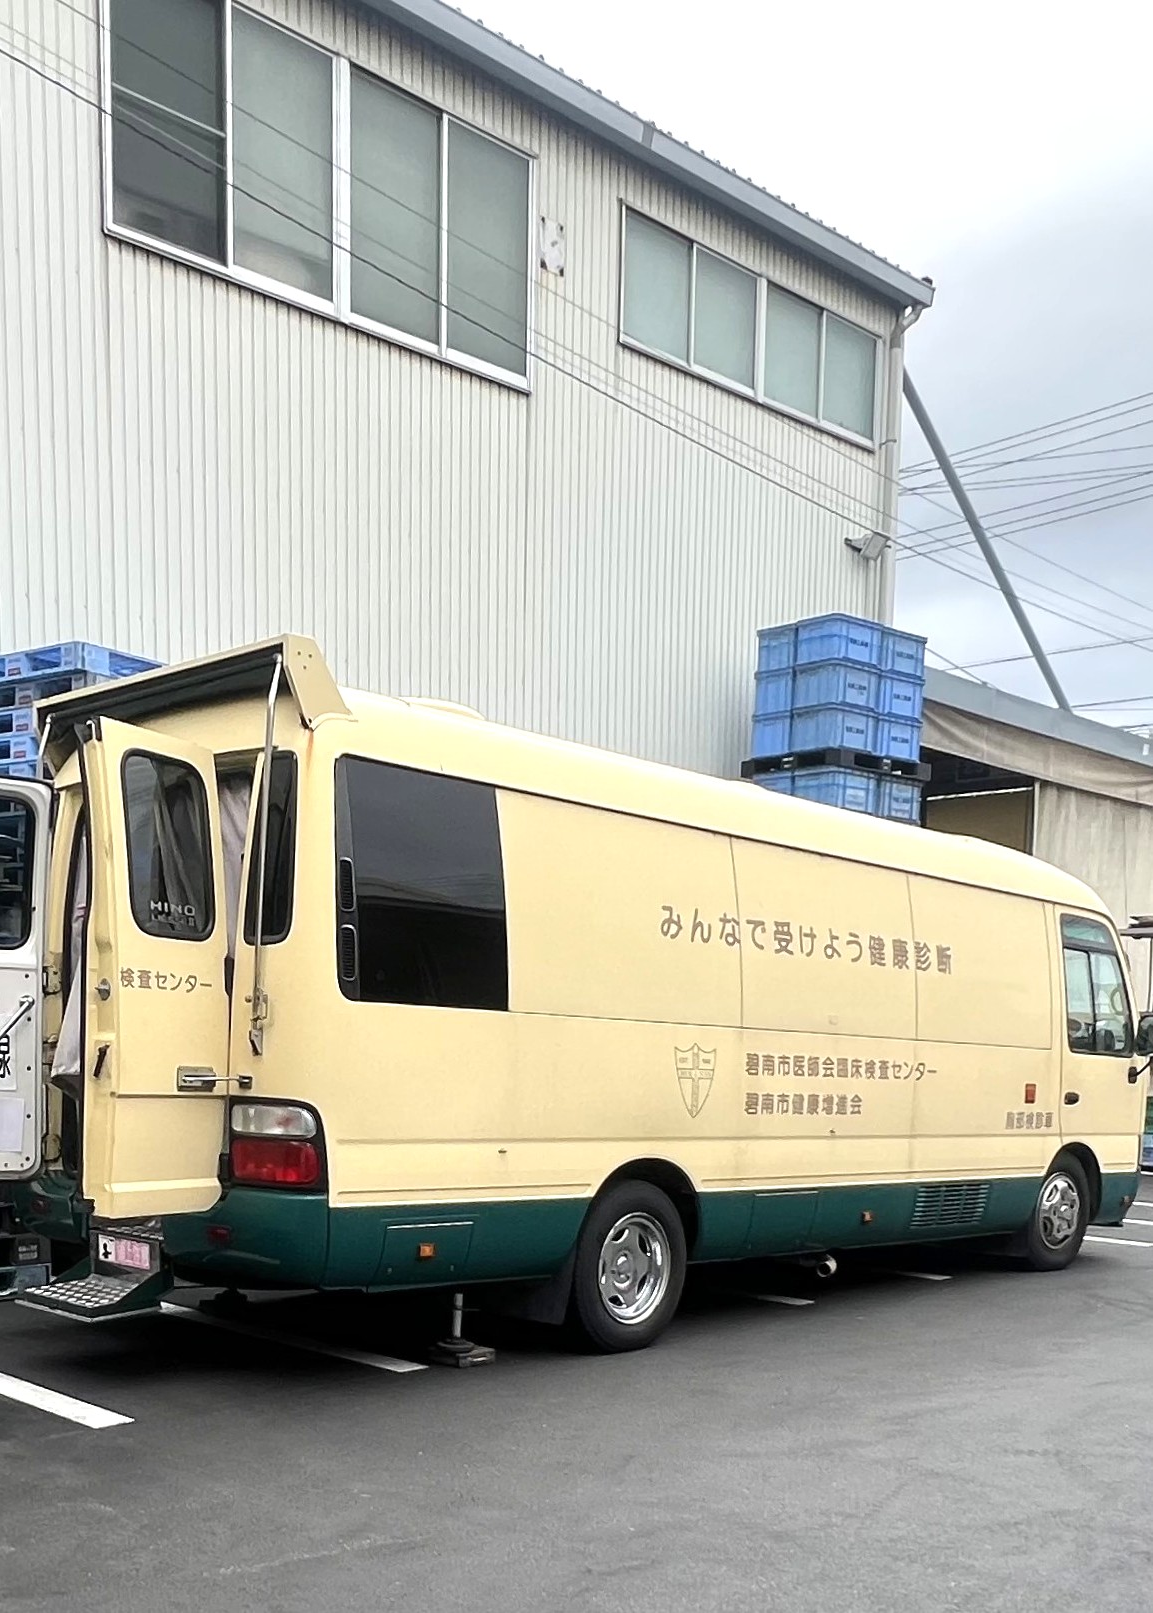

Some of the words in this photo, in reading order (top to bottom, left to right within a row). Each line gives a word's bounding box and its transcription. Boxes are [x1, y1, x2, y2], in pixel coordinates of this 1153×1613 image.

[150, 900, 196, 916] HINO
[660, 905, 952, 974] みんなで受けよう健康診断
[120, 967, 212, 993] 検査センター
